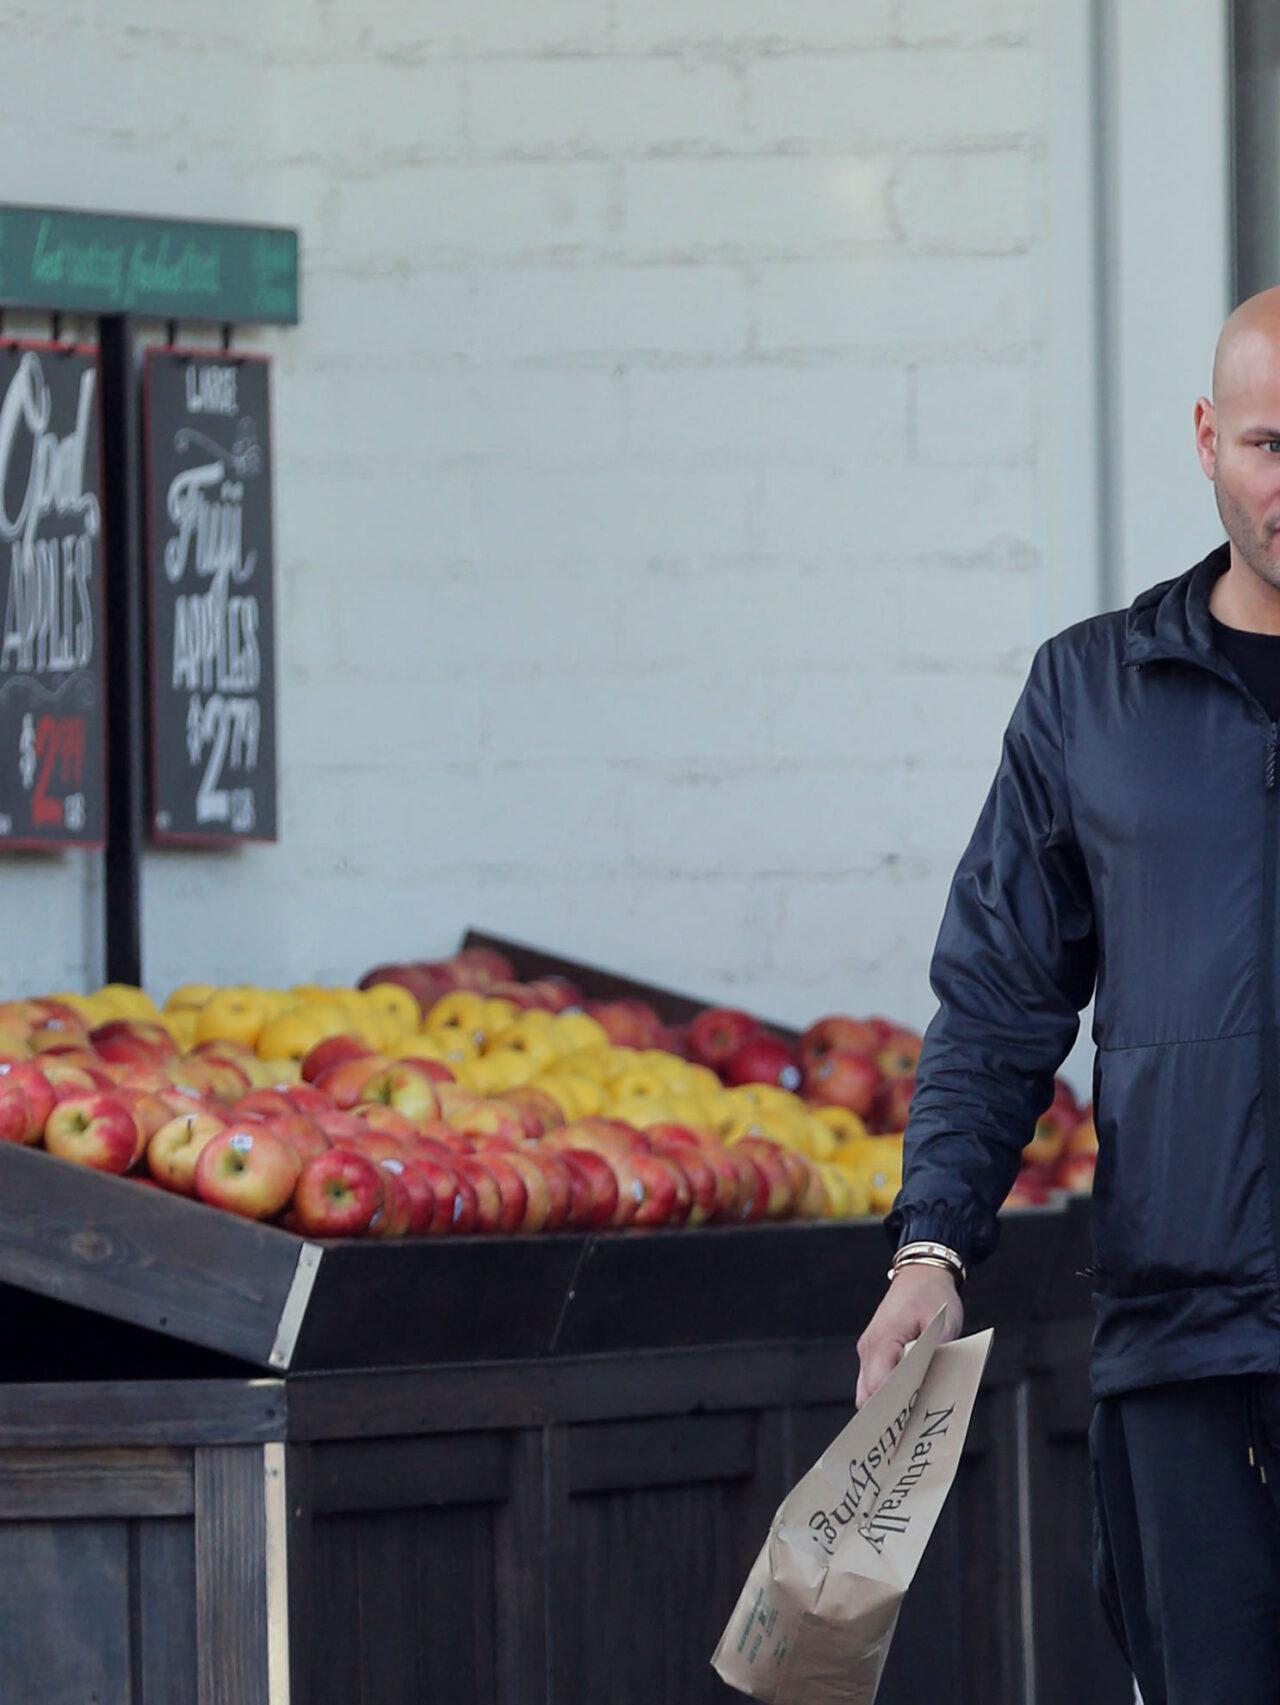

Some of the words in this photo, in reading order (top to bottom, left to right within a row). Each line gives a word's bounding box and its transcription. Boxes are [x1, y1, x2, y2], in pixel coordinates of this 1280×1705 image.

[1, 535, 94, 672] APPLES
[172, 594, 261, 691] APPLES
[858, 1402, 956, 1555] Naturally
